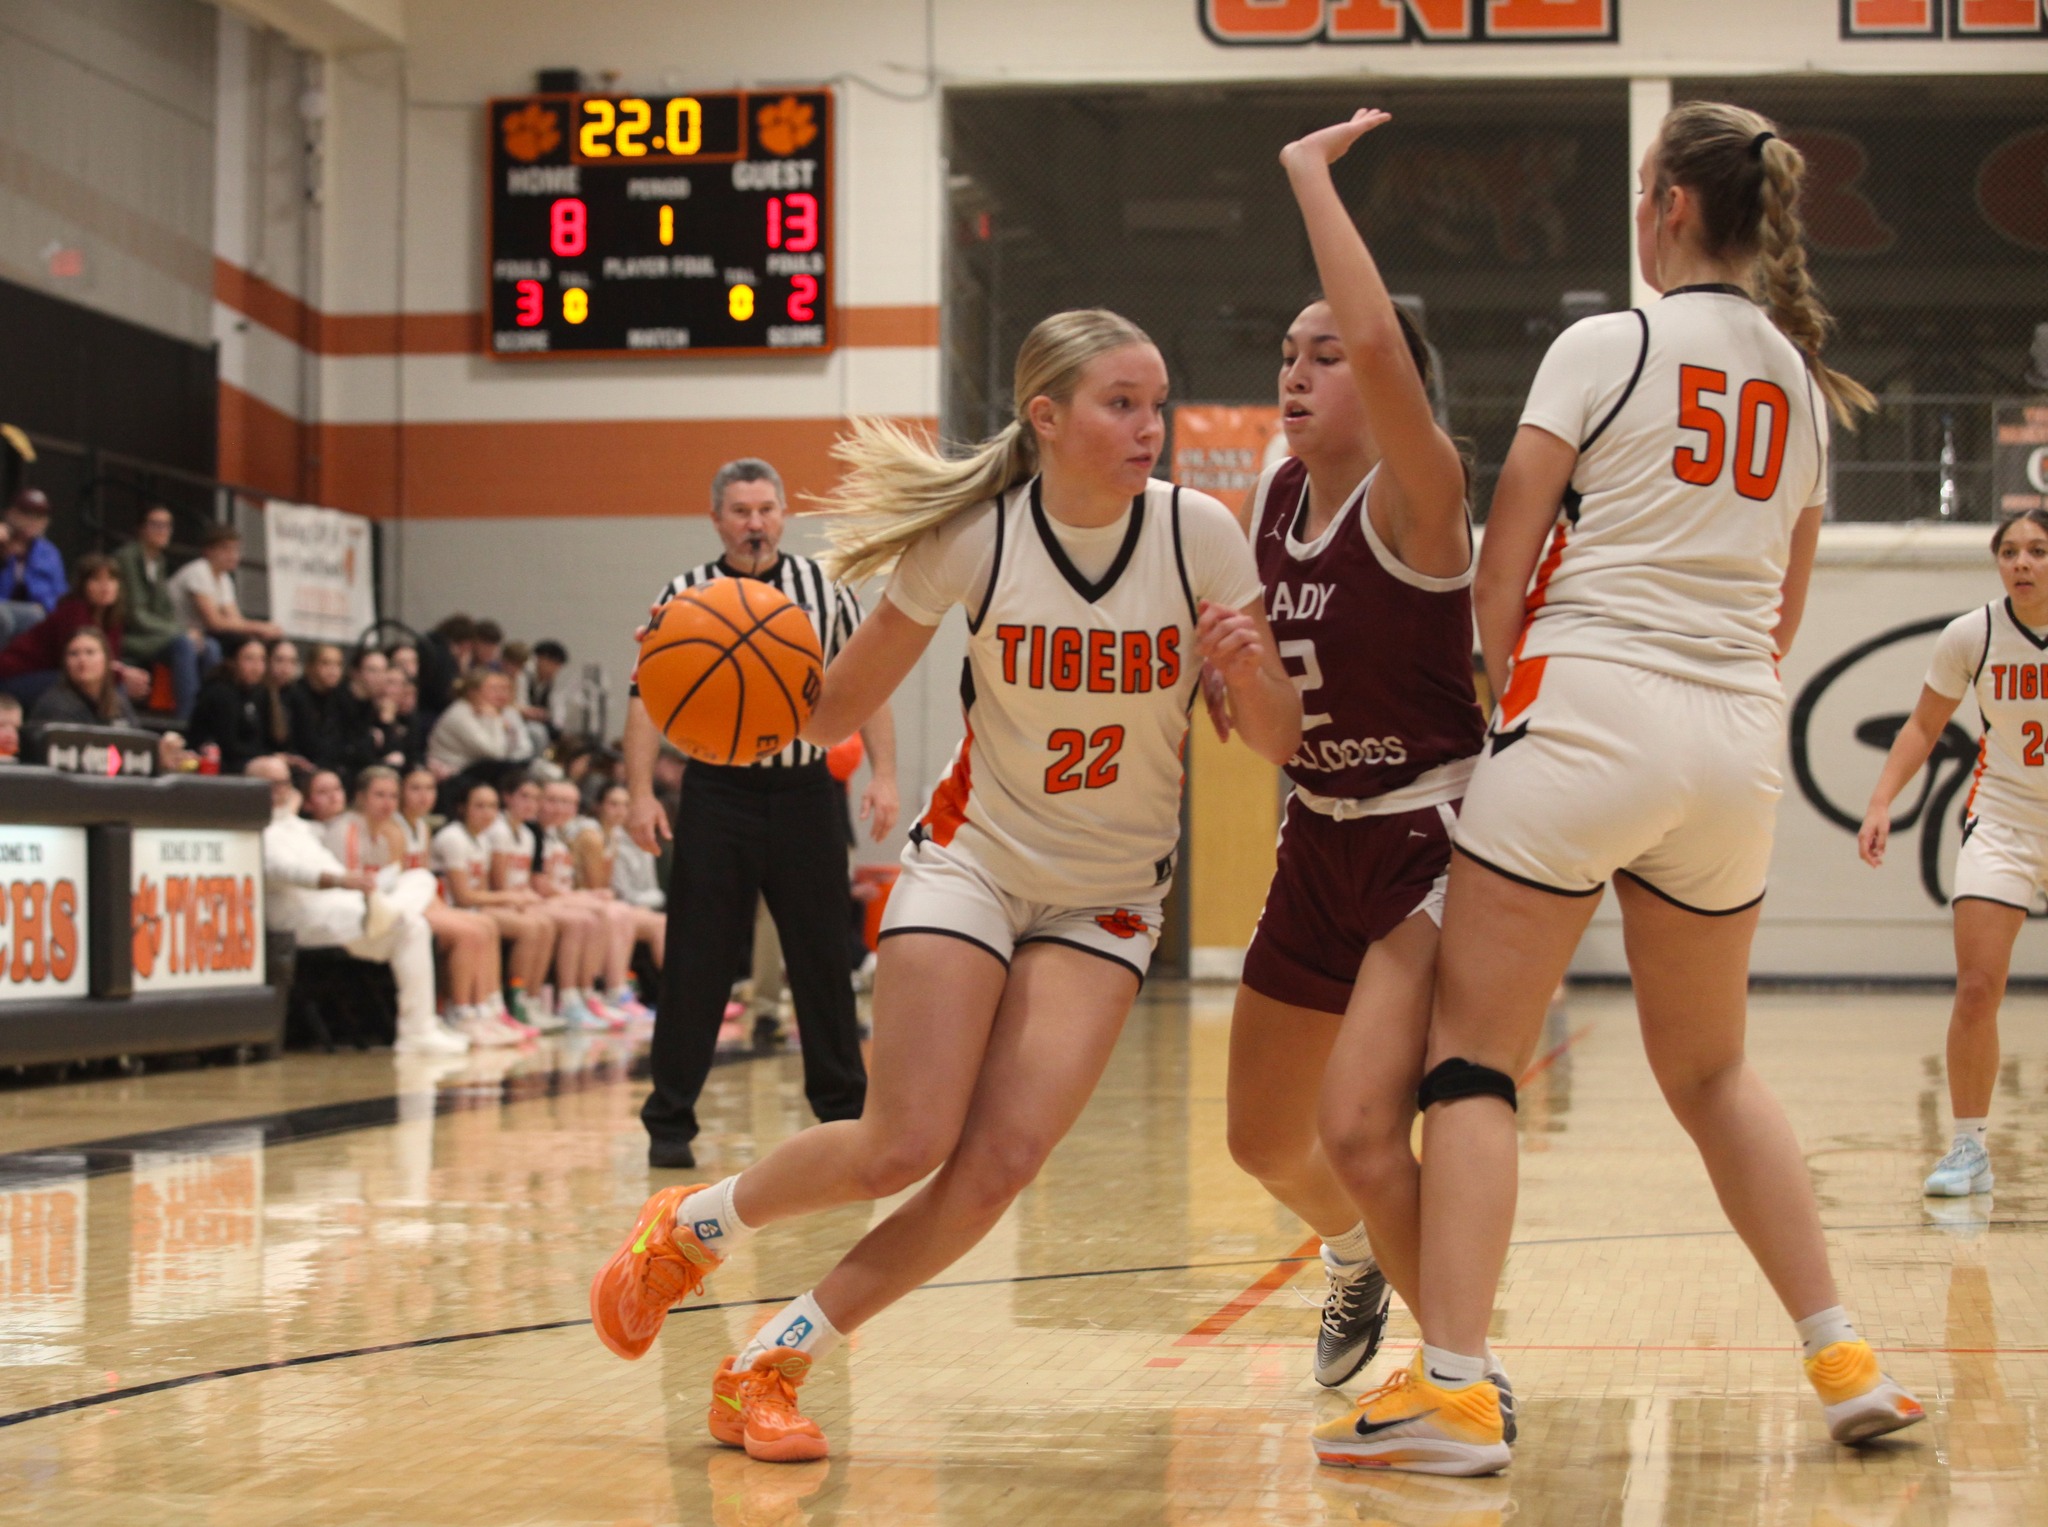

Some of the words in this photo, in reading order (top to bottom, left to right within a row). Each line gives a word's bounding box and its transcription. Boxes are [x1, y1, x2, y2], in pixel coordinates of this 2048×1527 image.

[579, 97, 702, 158] 22.0
[731, 160, 817, 192] GUEST
[550, 198, 588, 257] 8
[659, 204, 674, 246] 1
[766, 193, 819, 252] 13
[515, 279, 544, 327] 3
[787, 274, 819, 322] 2
[1672, 363, 1790, 502] 50
[996, 624, 1181, 694] TIGERS
[1043, 723, 1125, 795] 22
[2021, 720, 2048, 767] 2
[0, 878, 78, 983] HS
[164, 873, 256, 974] TIGERS
